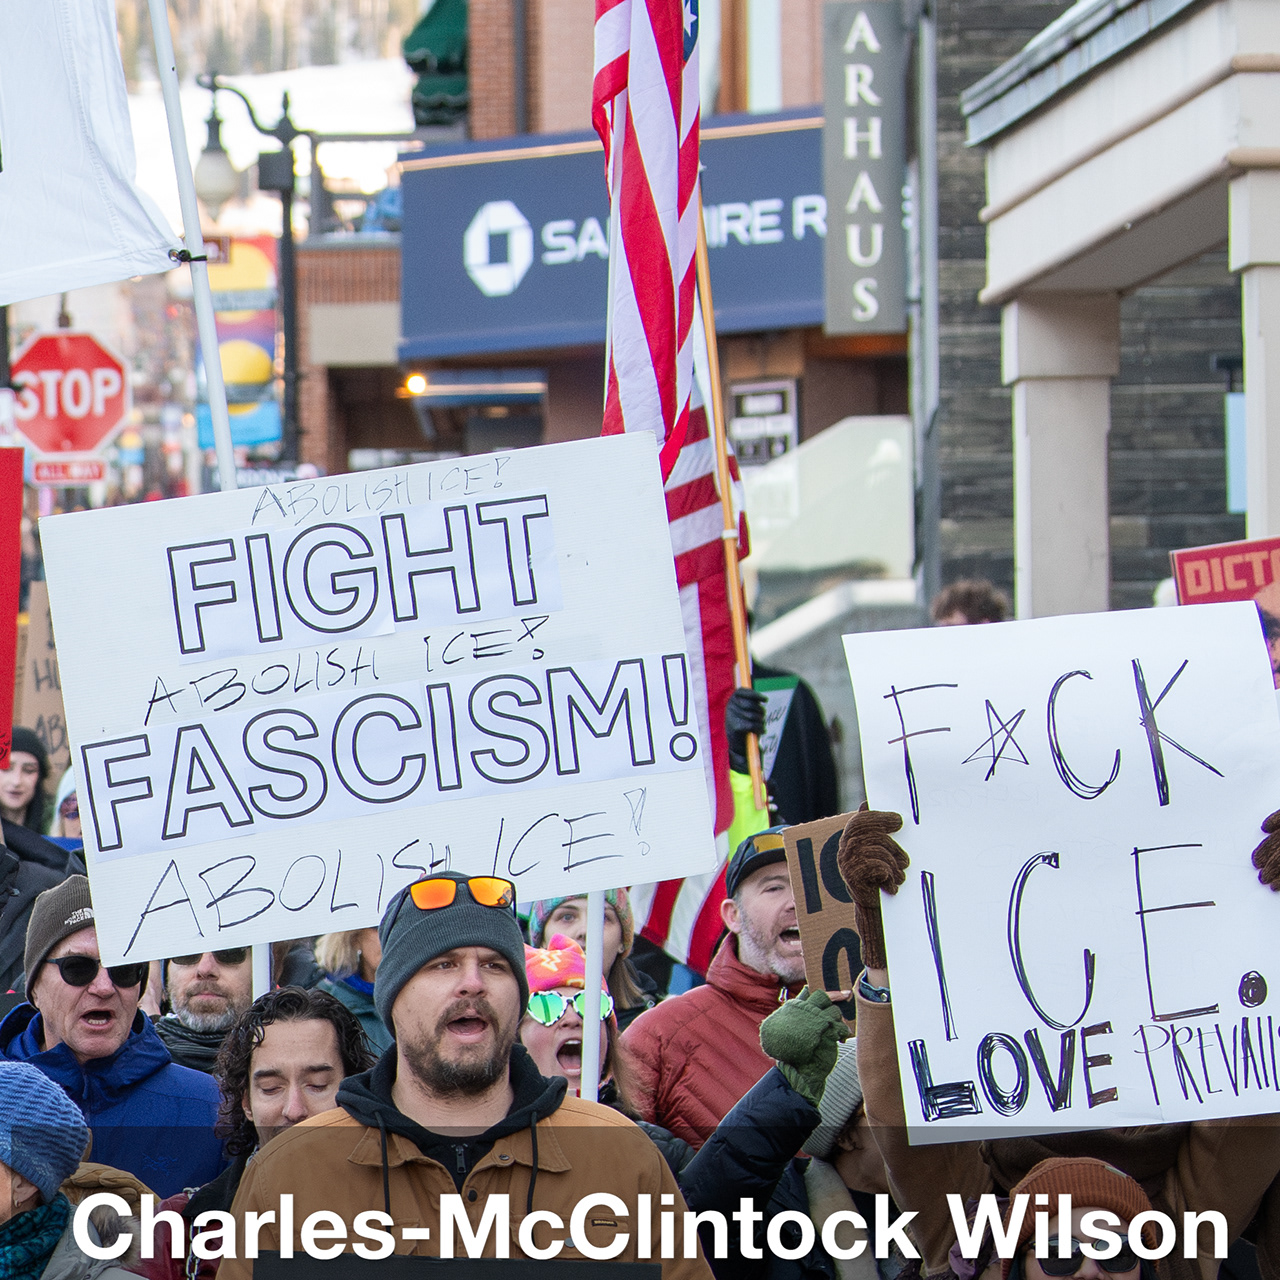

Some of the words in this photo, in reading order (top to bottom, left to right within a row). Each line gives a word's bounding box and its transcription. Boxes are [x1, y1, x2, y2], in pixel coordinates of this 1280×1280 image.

[843, 11, 884, 322] ARHAUS
[541, 197, 783, 265] SAIRE
[12, 367, 123, 421] STOP
[251, 473, 410, 525] ABOLISH
[428, 456, 510, 497] ICE!
[166, 494, 548, 655] FIGHT
[145, 647, 378, 726] ABOLISH
[426, 615, 550, 667] ICE!
[81, 653, 698, 853] FASCISM!
[492, 786, 652, 879] ICE!
[920, 844, 1269, 1043] ICE.
[907, 1021, 1119, 1123] LOVE
[1133, 1014, 1280, 1106] PREVAIL
